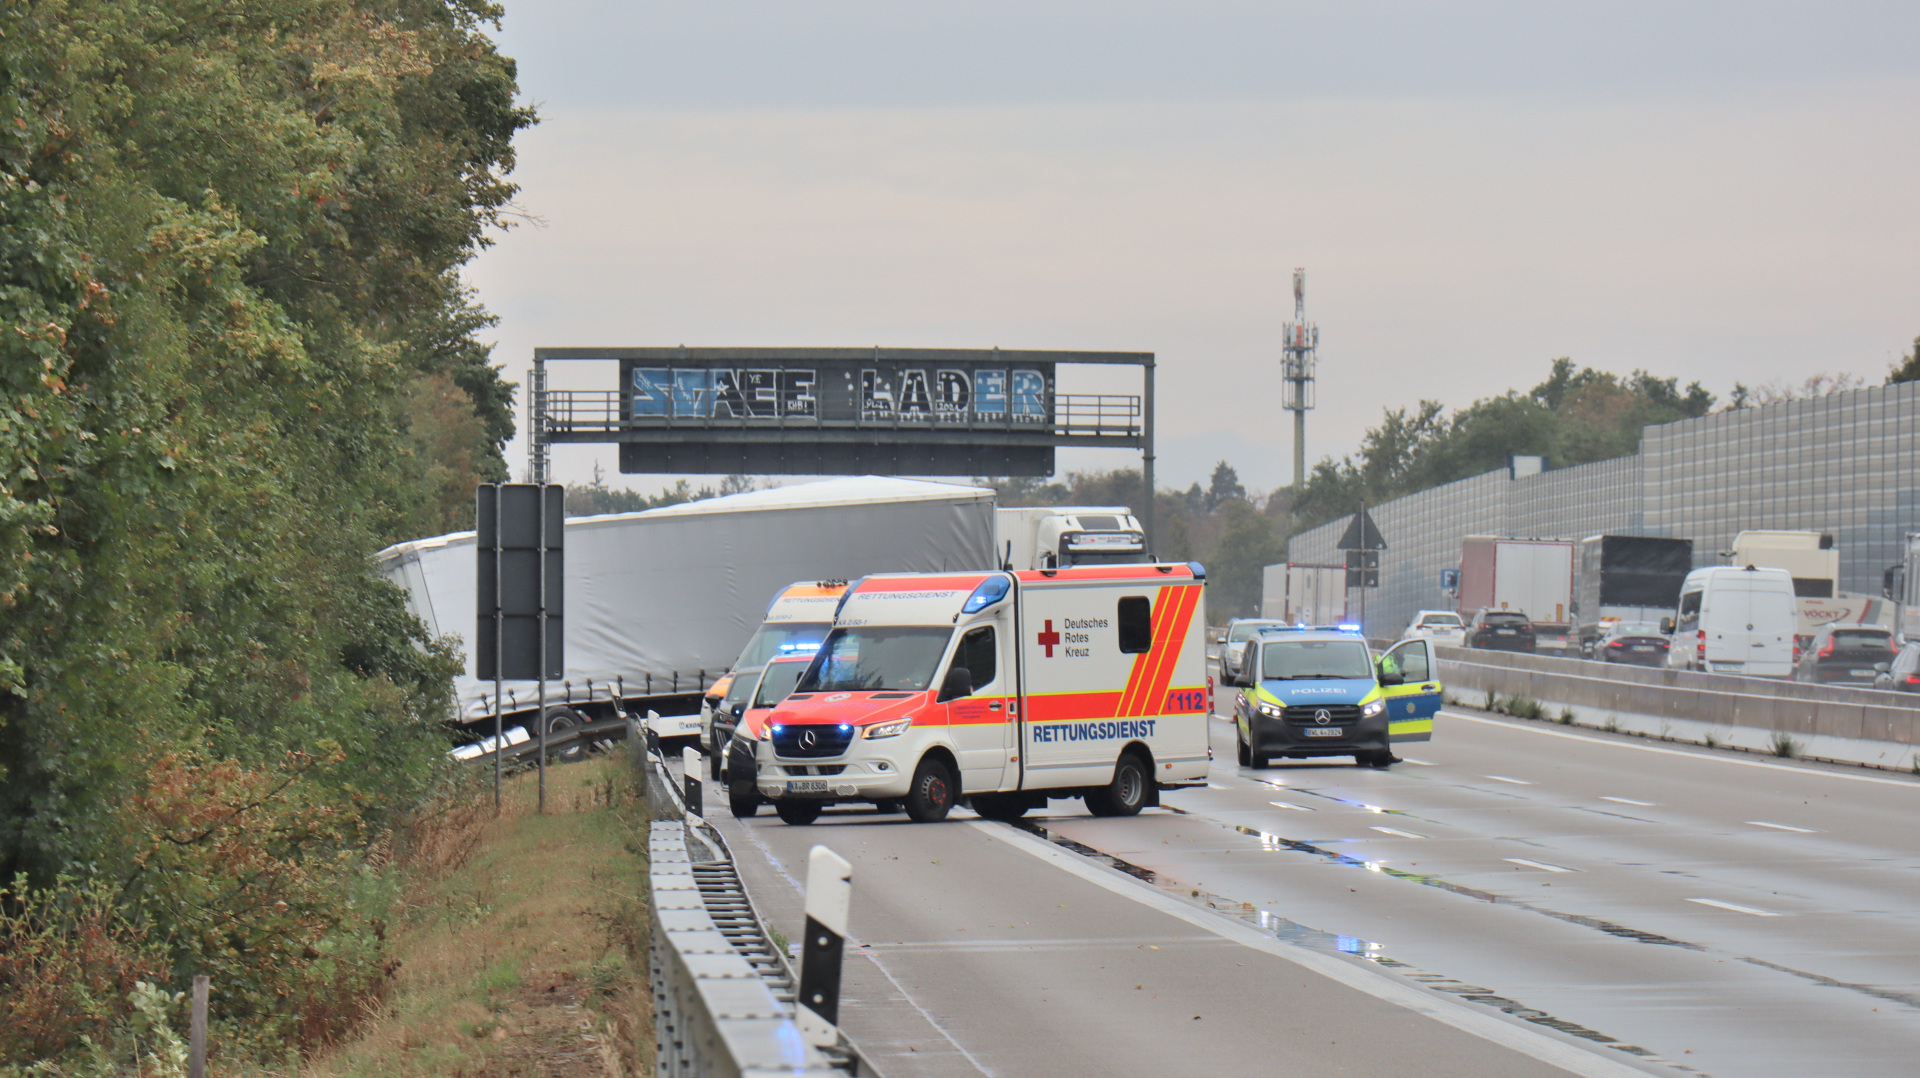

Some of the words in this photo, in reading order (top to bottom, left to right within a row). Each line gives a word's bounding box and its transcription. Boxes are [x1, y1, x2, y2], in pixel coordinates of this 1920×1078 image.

[857, 591, 957, 600] RETTUNGSDIENST
[1064, 617, 1108, 629] Deutsches
[1065, 632, 1089, 643] Rotes
[1065, 646, 1089, 657] Kreuz
[1291, 687, 1347, 695] POLIZEI
[1177, 692, 1203, 710] 112
[1033, 720, 1156, 743] RETTUNGSDIENST
